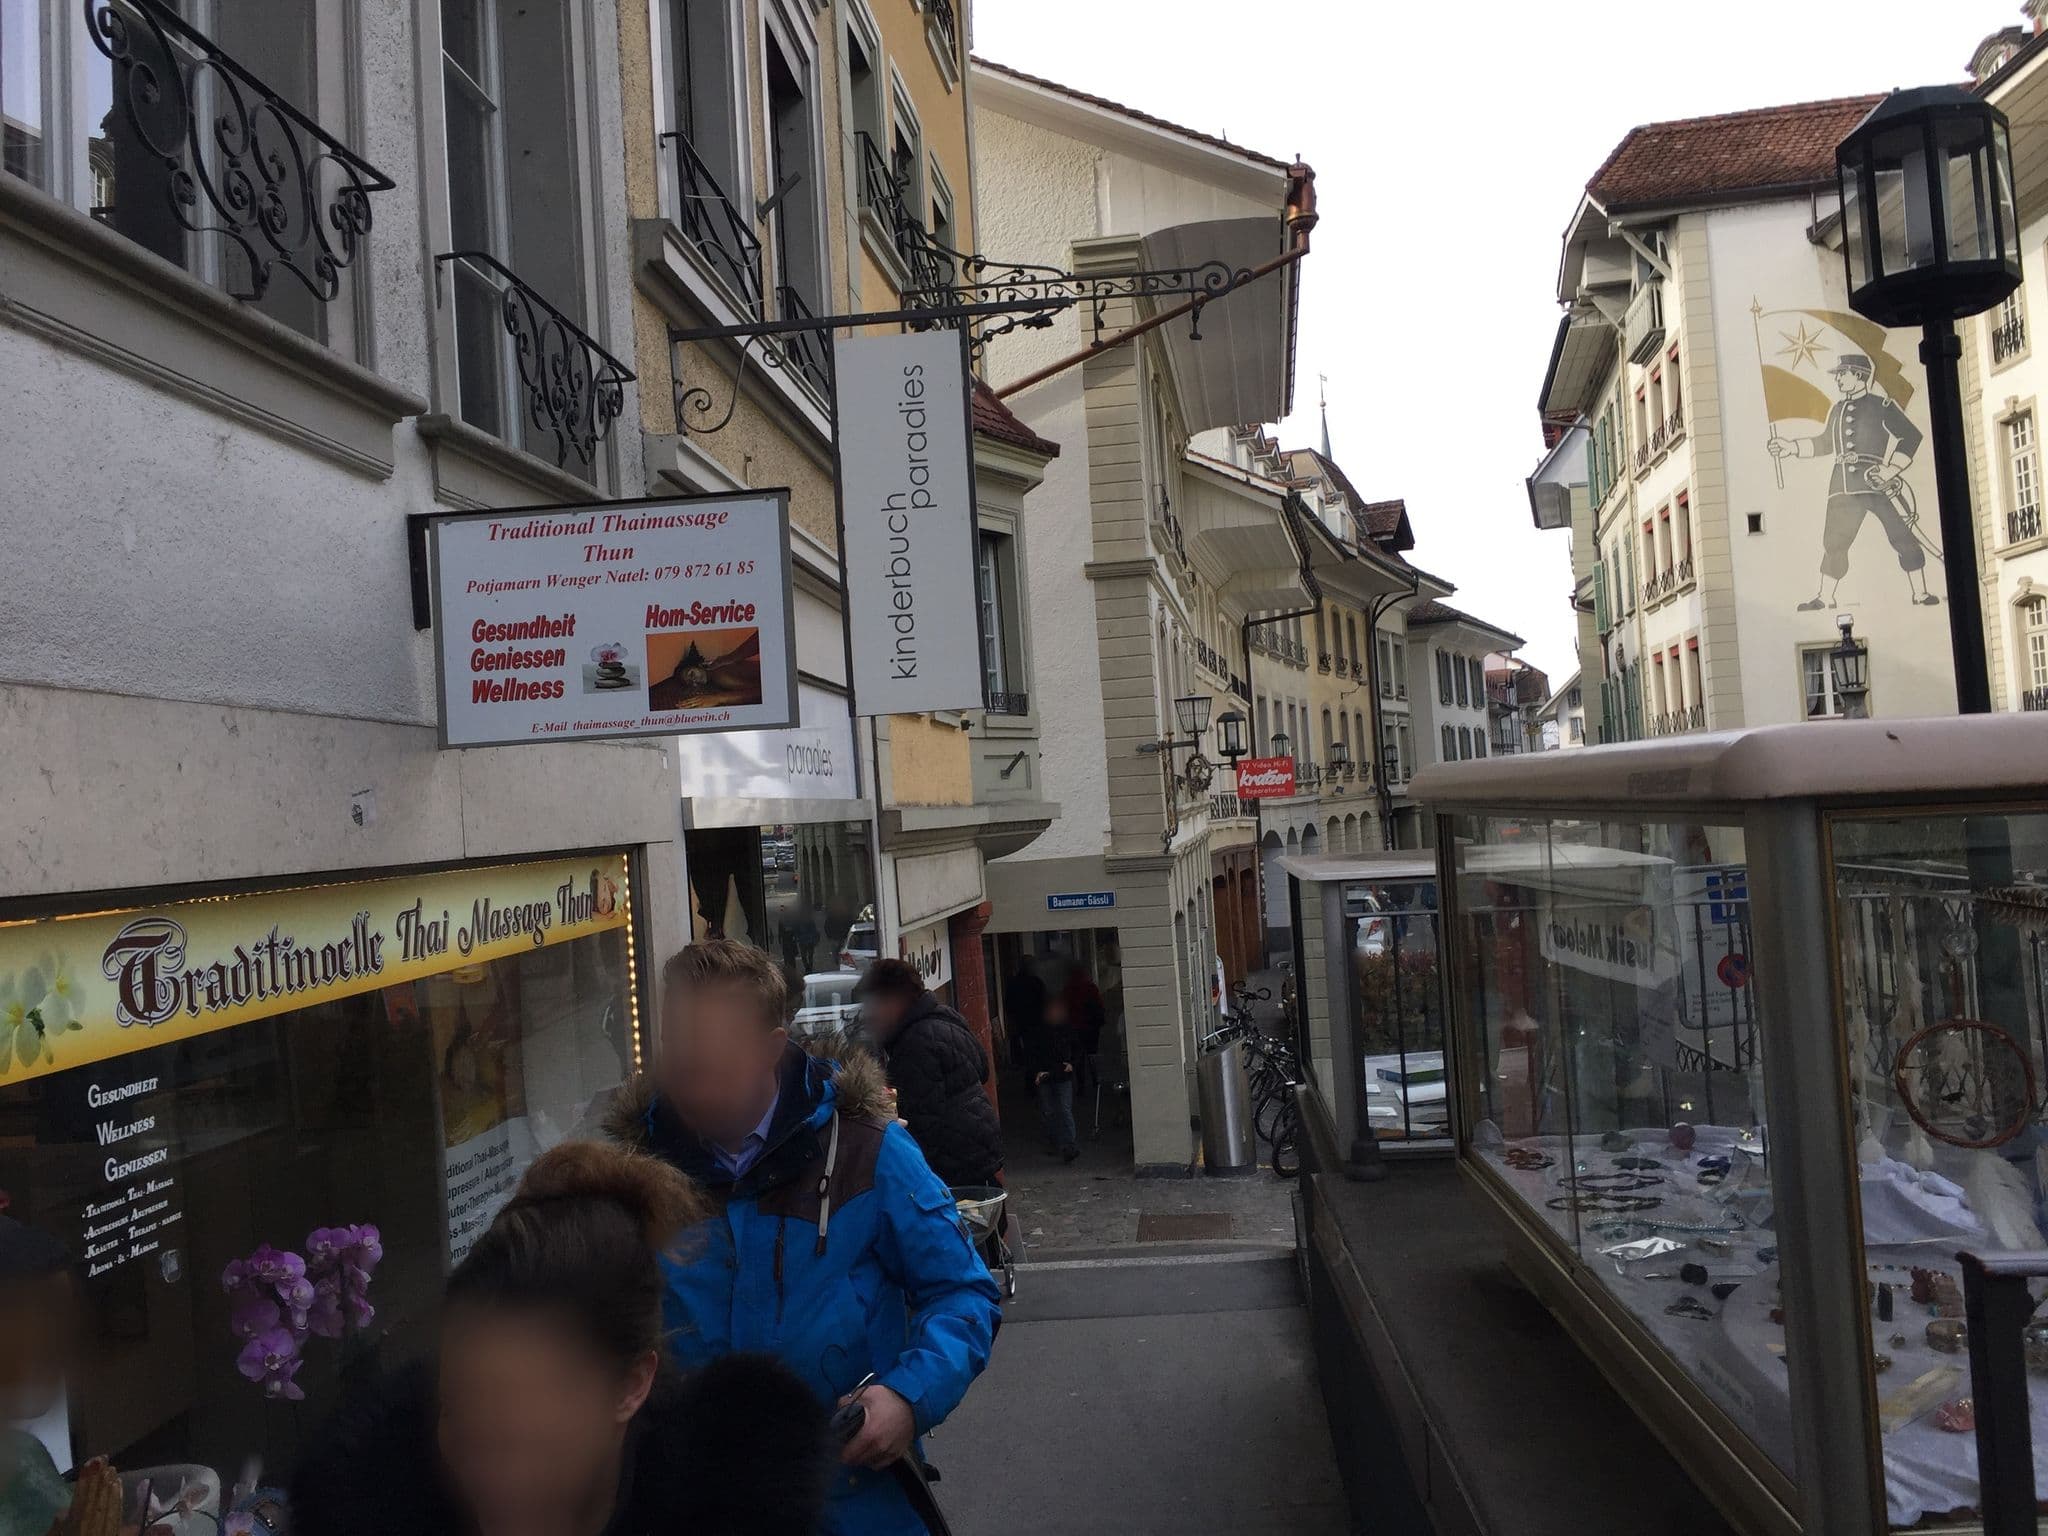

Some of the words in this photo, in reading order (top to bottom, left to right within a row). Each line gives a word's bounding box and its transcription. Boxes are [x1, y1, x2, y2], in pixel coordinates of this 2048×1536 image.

[899, 364, 938, 510] paradies
[488, 516, 595, 541] Traditional
[602, 511, 729, 533] Thaimassage
[583, 544, 634, 562] Thun
[466, 578, 541, 595] Potjamarn
[547, 573, 601, 589] Wenger
[605, 568, 649, 583] Natel:
[655, 565, 681, 580] 079
[684, 563, 711, 578] 872
[715, 562, 732, 576] 61
[737, 560, 755, 574] 85
[881, 492, 918, 680] kinderbuch
[471, 613, 576, 643] Gesundheit
[645, 599, 756, 628] Hom-Service
[470, 646, 566, 672] Geniessen
[471, 677, 565, 704] Wellness
[531, 721, 567, 733] E-Mail
[573, 713, 731, 730] thaimassage_thun@bluewin.ch
[786, 738, 833, 784] paradies
[396, 897, 450, 961] Thai
[457, 897, 551, 947] Massage
[557, 875, 593, 926] Thun
